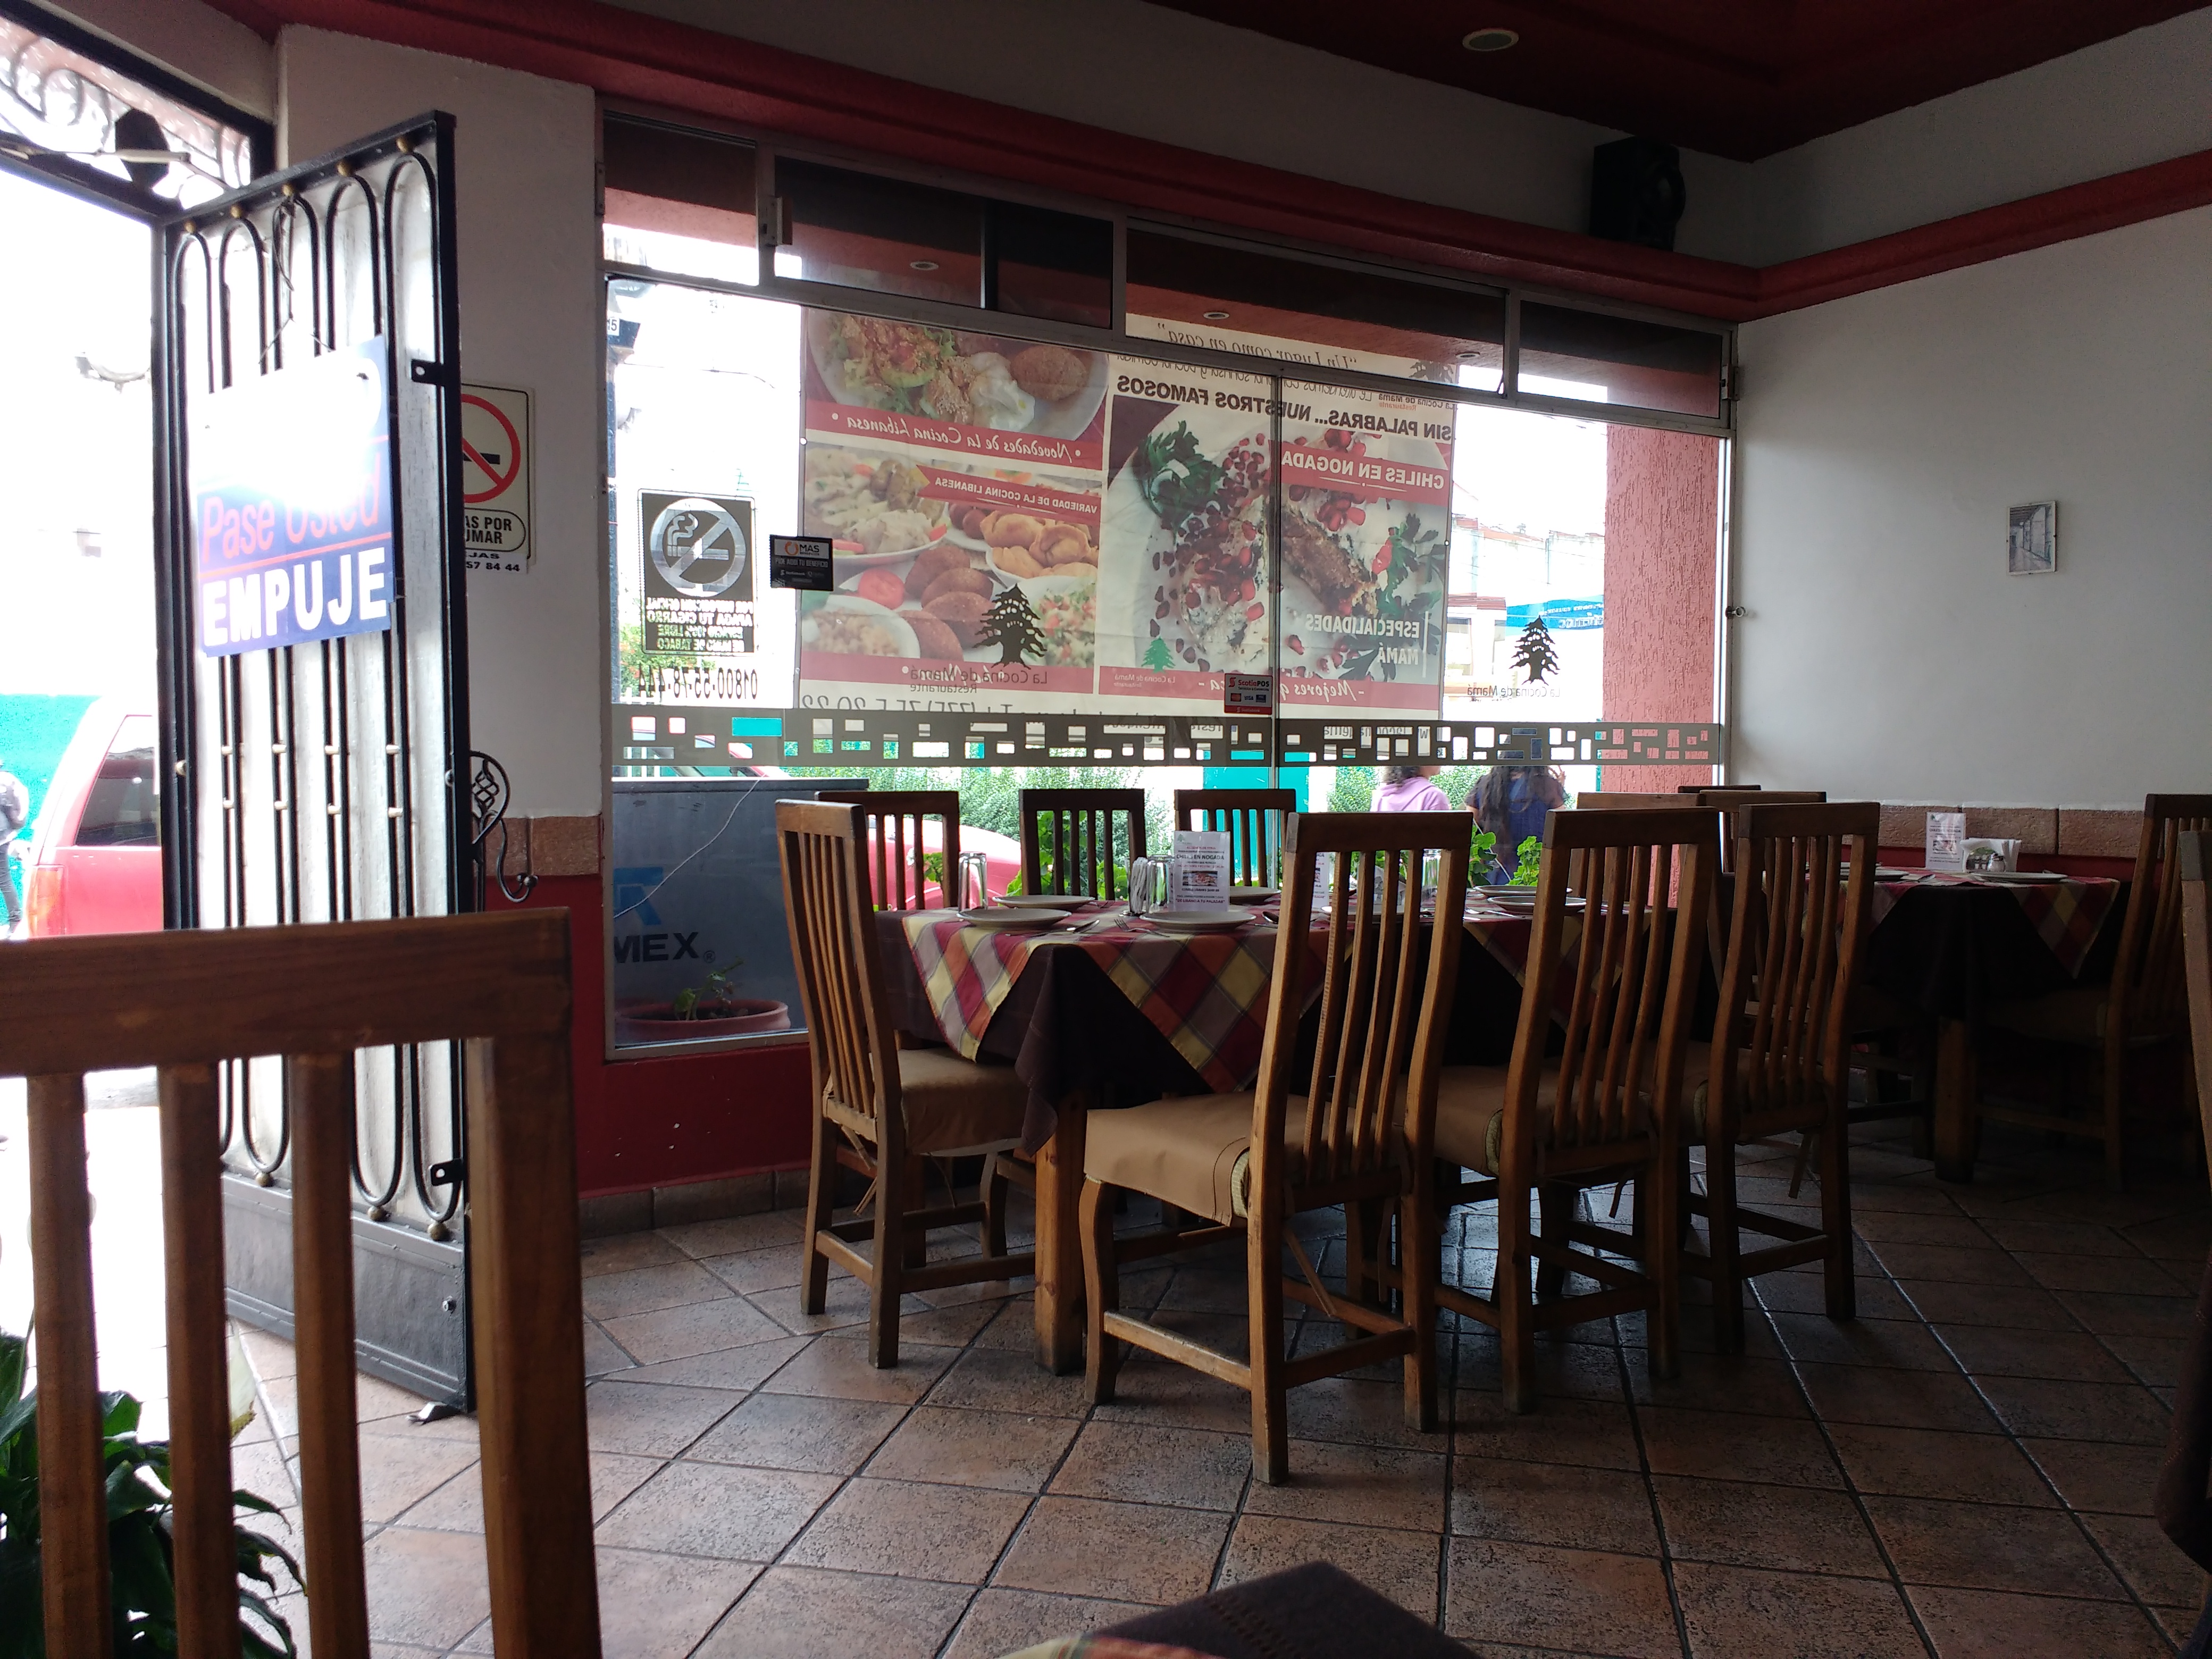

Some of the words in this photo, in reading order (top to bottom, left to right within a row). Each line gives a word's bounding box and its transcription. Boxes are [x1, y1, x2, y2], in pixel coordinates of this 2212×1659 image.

[202, 496, 275, 564] Pase
[484, 517, 512, 531] POR
[800, 544, 819, 552] MAS
[203, 547, 387, 647] EMPUJE
